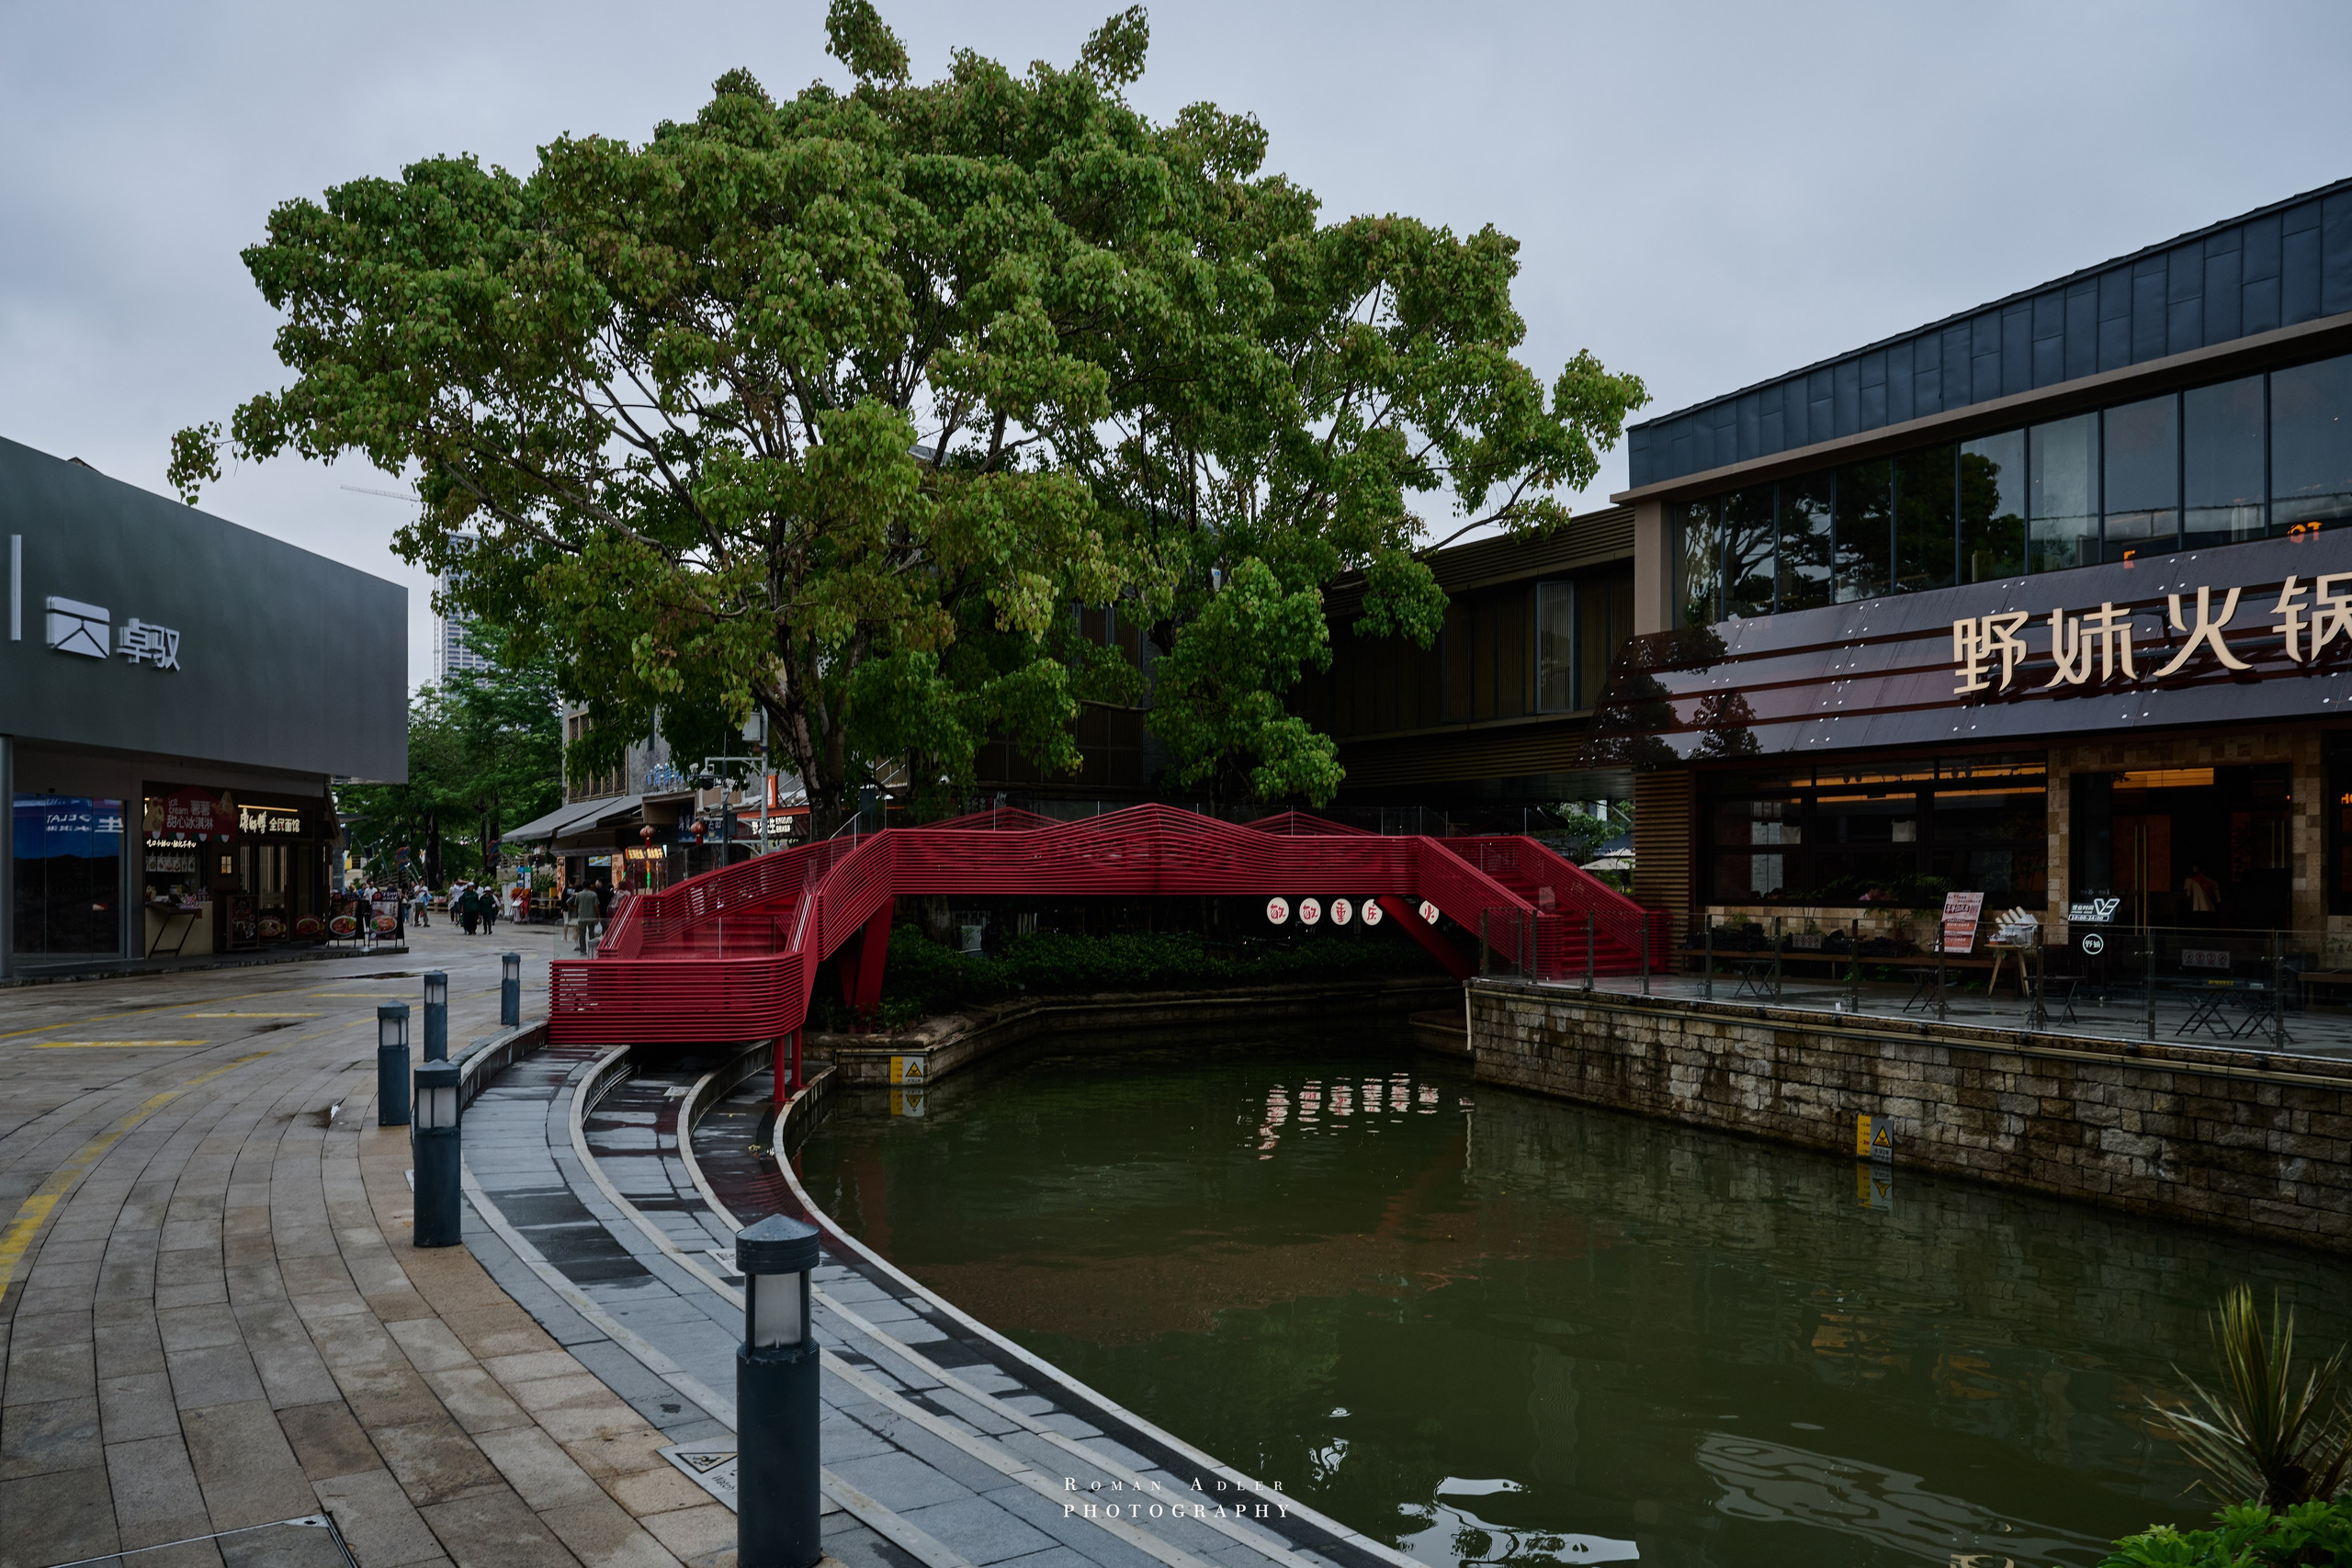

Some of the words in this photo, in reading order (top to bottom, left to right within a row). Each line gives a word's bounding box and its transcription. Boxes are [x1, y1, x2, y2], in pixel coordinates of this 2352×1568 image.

[1953, 571, 2352, 694] 野妹火锅
[117, 617, 181, 671] 卓驭
[168, 797, 178, 808] ice
[168, 807, 189, 816] cream
[166, 815, 214, 830] 甜心冰淇淋
[268, 817, 300, 833] 全民面馆
